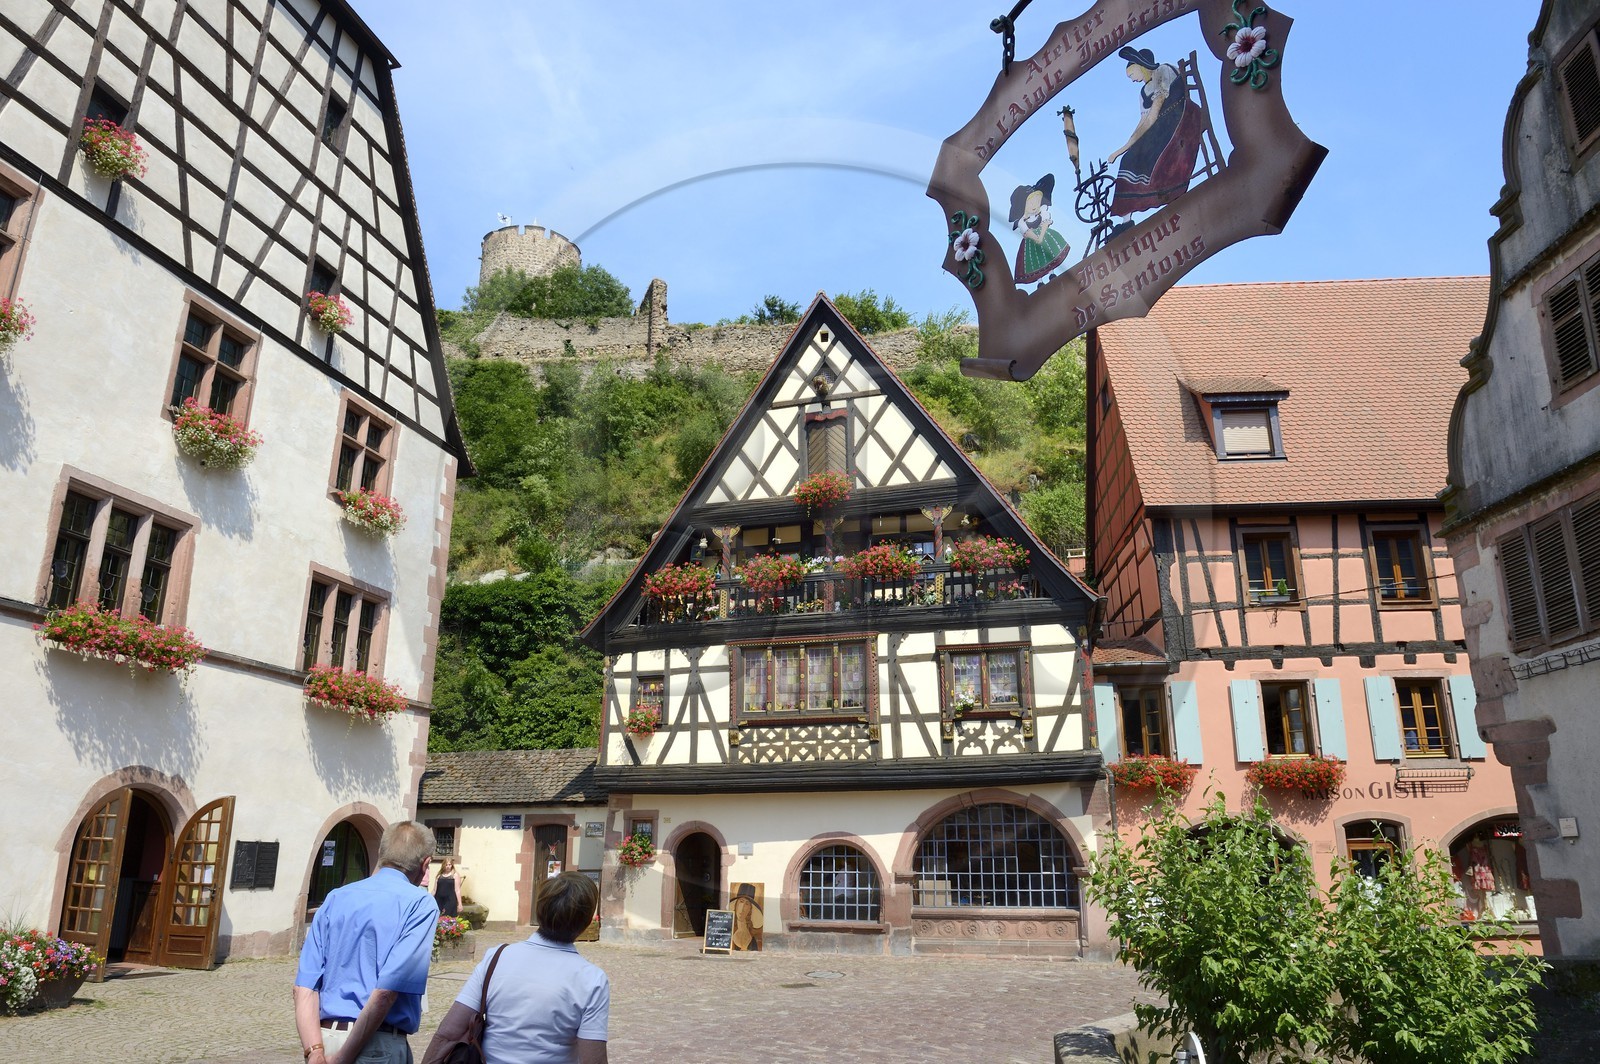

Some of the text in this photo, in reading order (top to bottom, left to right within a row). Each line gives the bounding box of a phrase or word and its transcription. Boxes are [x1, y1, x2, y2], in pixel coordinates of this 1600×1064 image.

[1025, 8, 1105, 84] Atelier
[975, 137, 995, 161] de
[1072, 235, 1206, 329] de Santons
[1078, 213, 1181, 295] Fabrique
